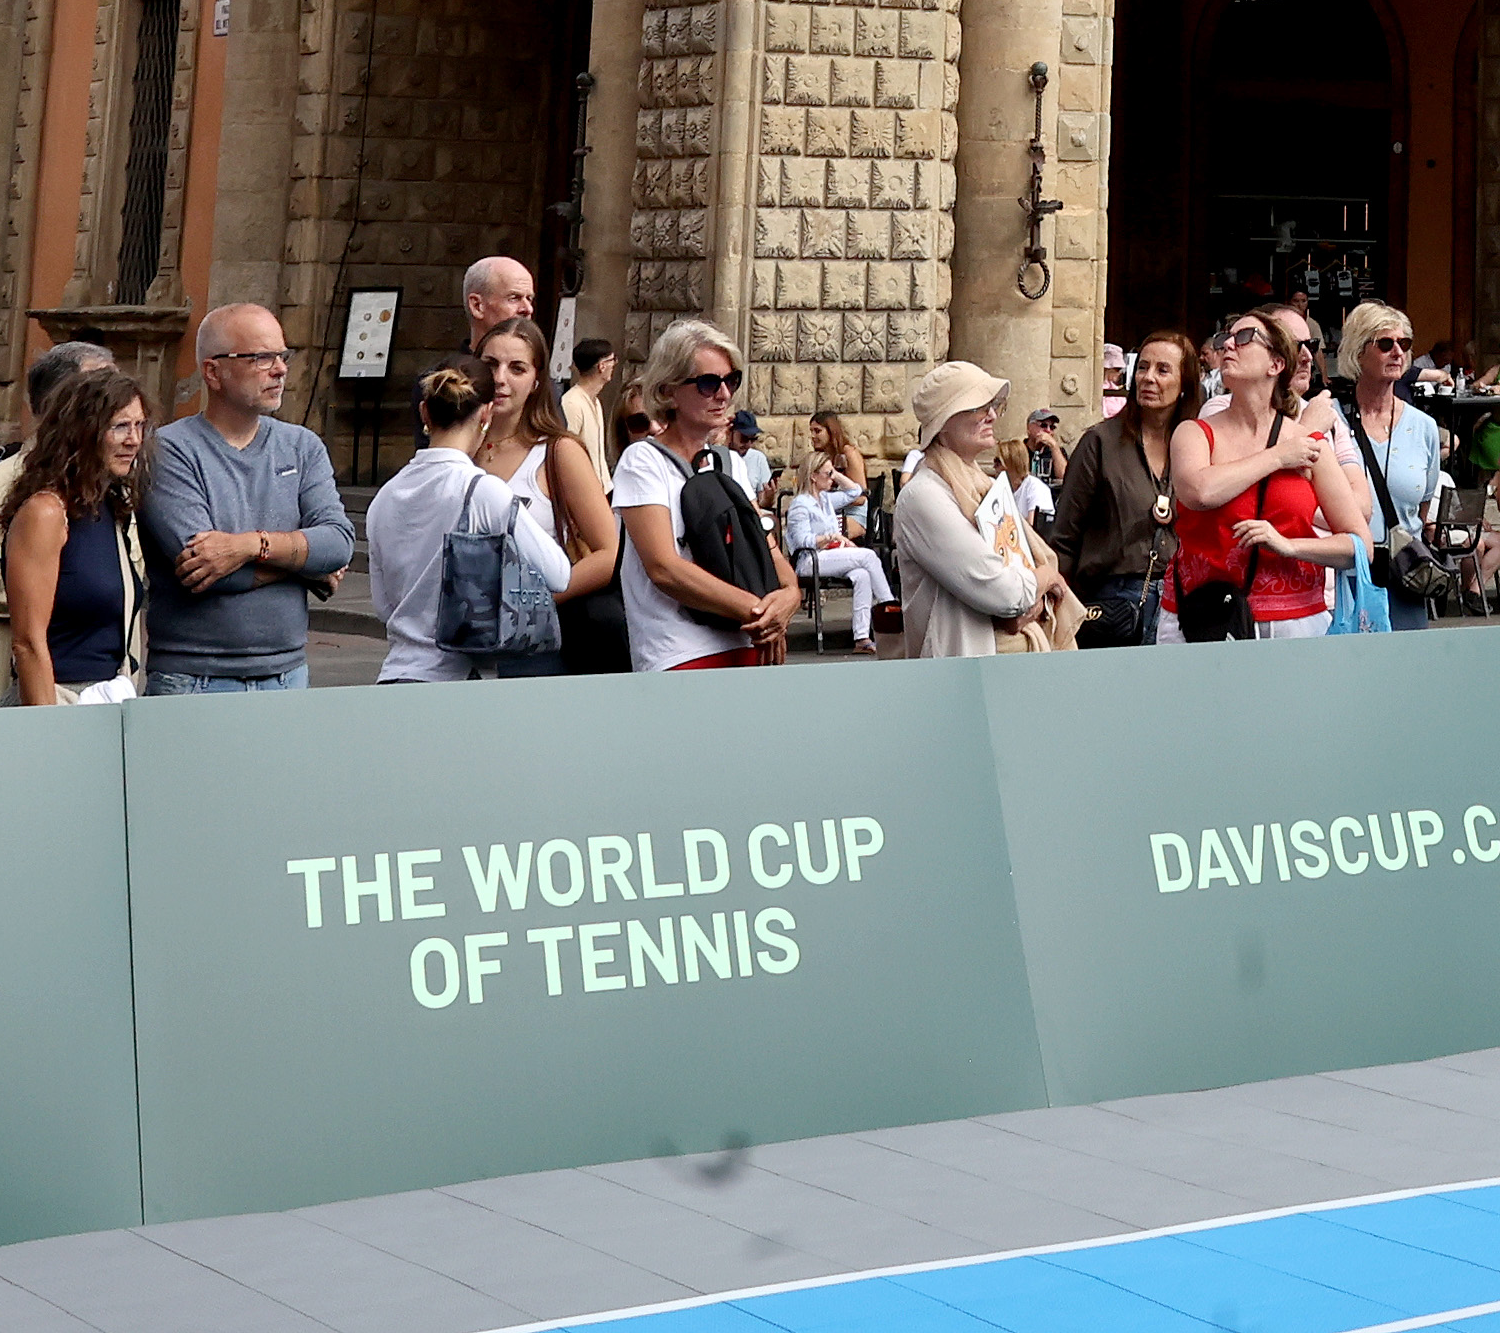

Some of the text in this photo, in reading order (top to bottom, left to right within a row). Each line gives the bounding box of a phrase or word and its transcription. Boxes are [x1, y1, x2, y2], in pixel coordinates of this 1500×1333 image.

[286, 816, 885, 929] THE WORLD CUP
[410, 907, 801, 1009] OF TENNIS
